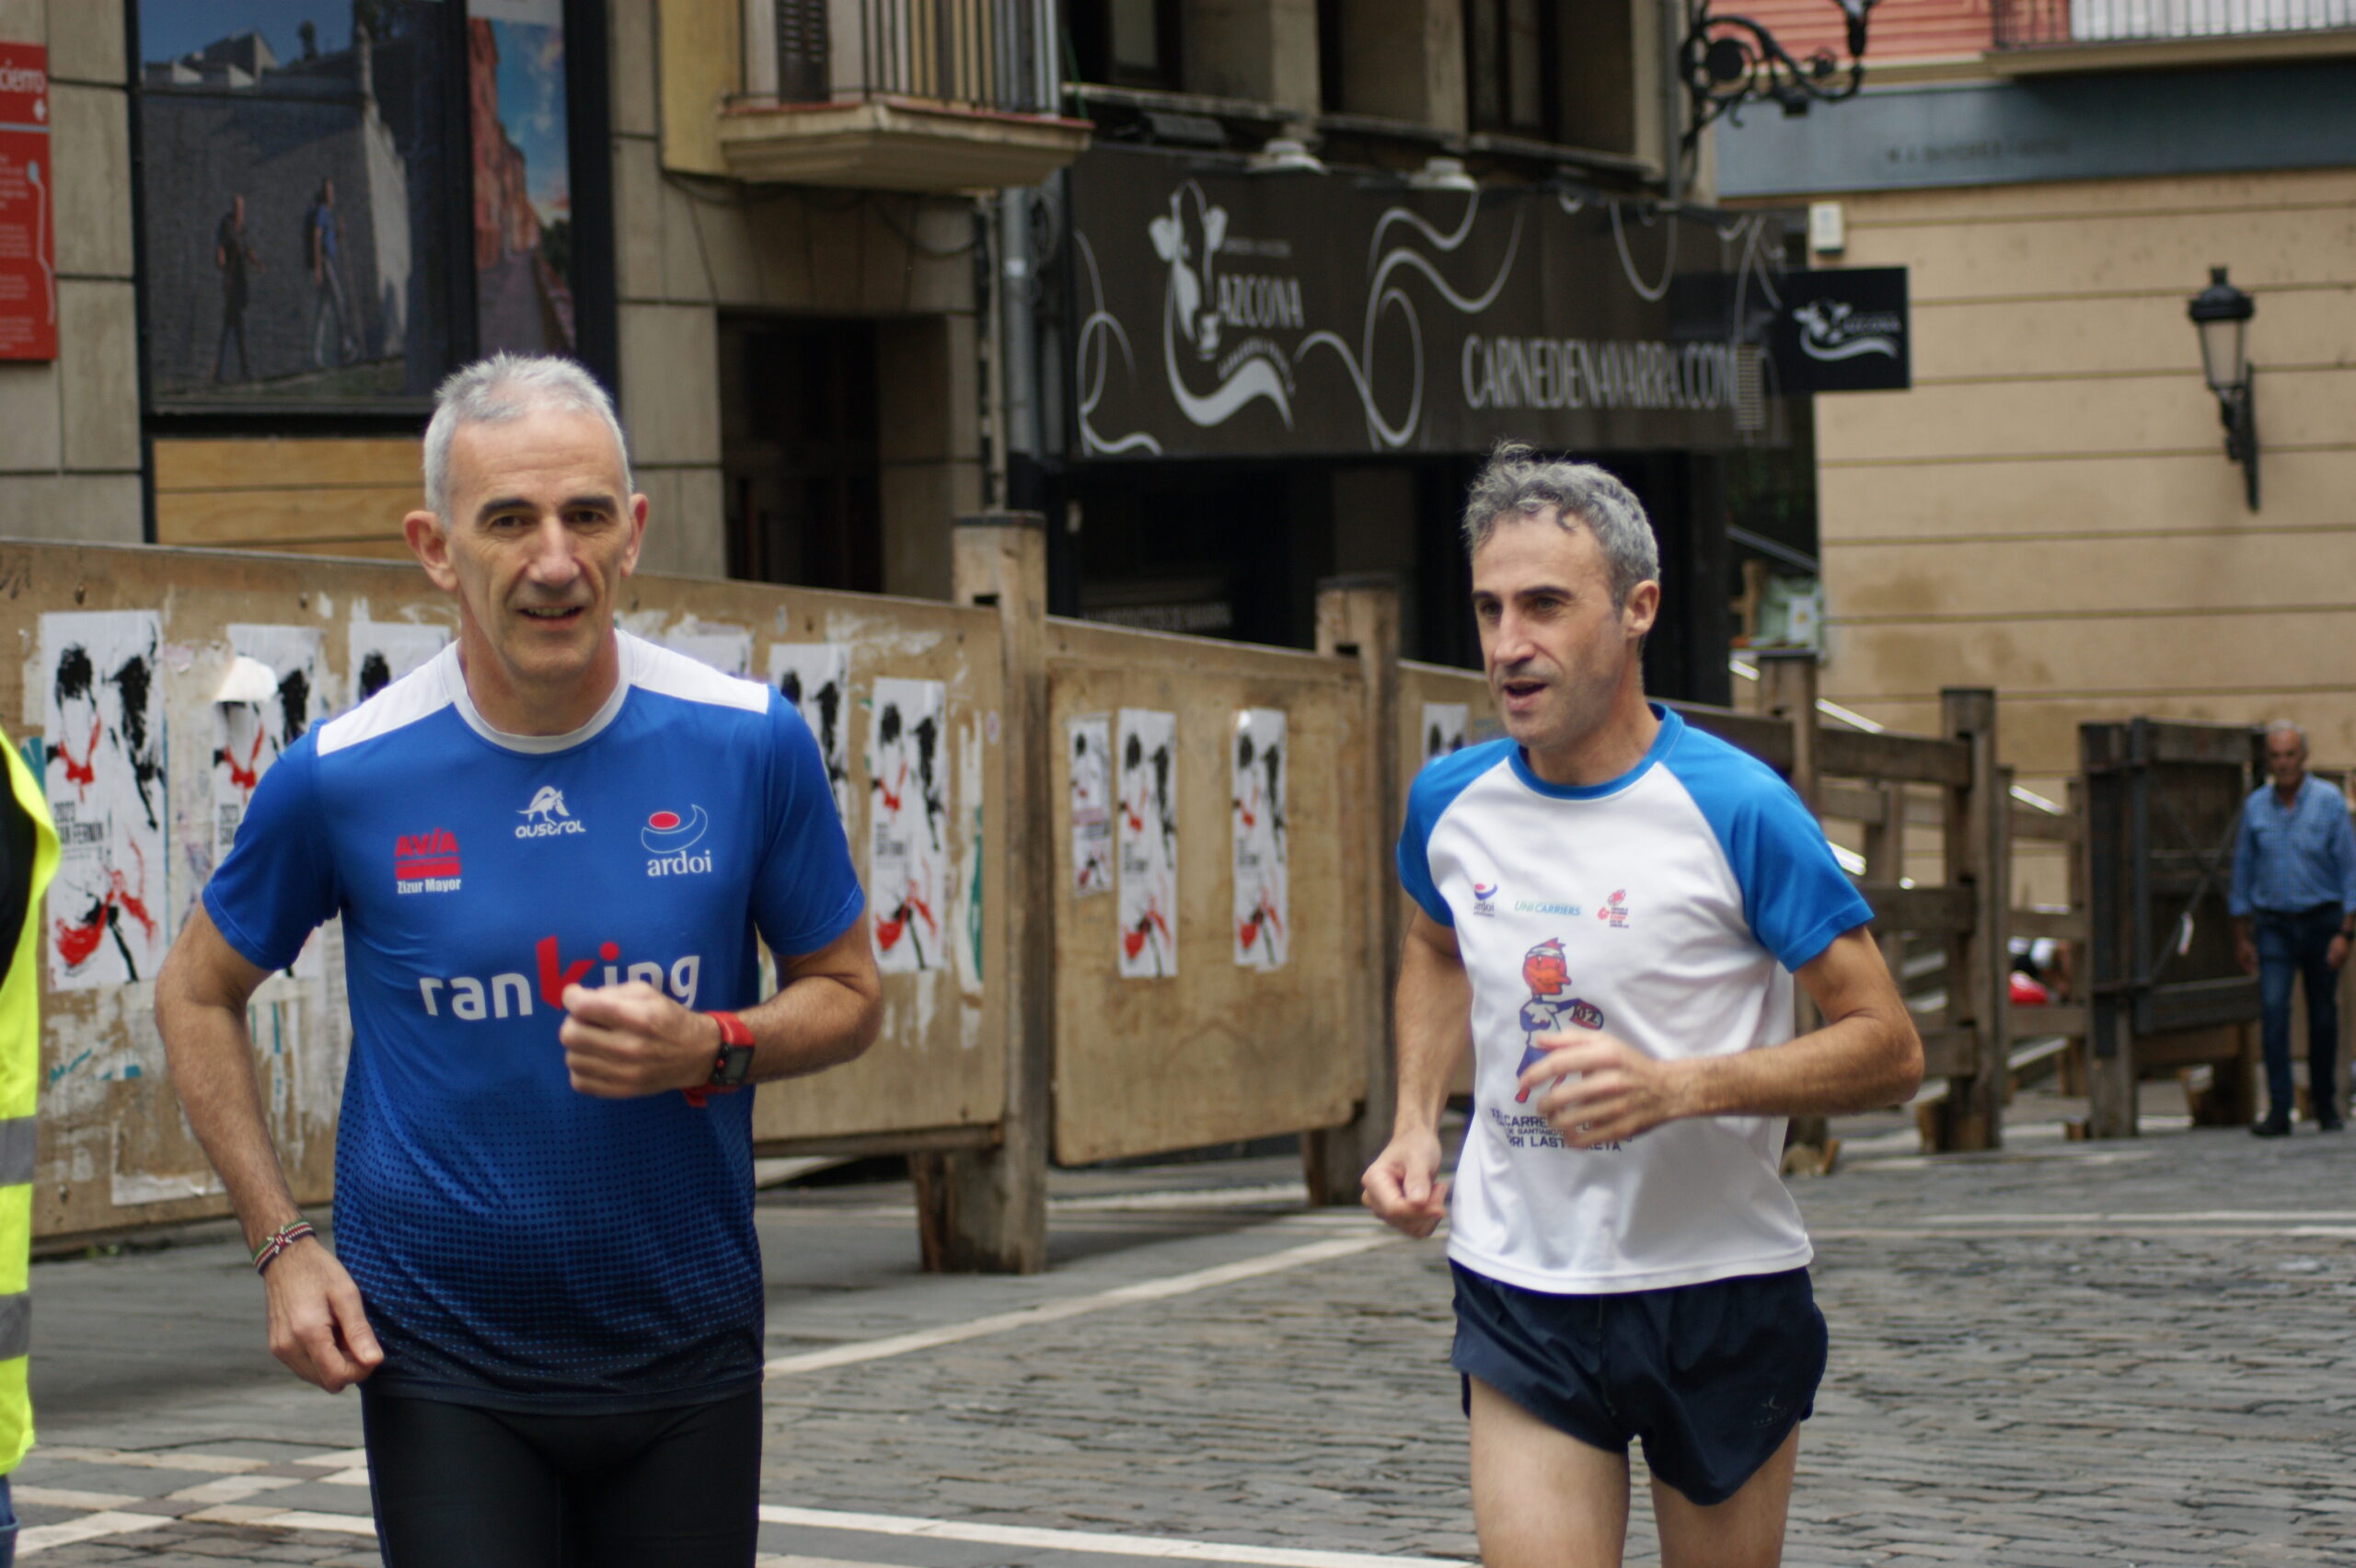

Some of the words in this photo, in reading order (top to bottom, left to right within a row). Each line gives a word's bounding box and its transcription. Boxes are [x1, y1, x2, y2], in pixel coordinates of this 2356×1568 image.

[1218, 273, 1304, 329] AZCONA
[394, 827, 459, 858] AVIA
[647, 849, 712, 877] ardoi
[397, 880, 423, 894] Zizur
[424, 878, 462, 894] Mayor
